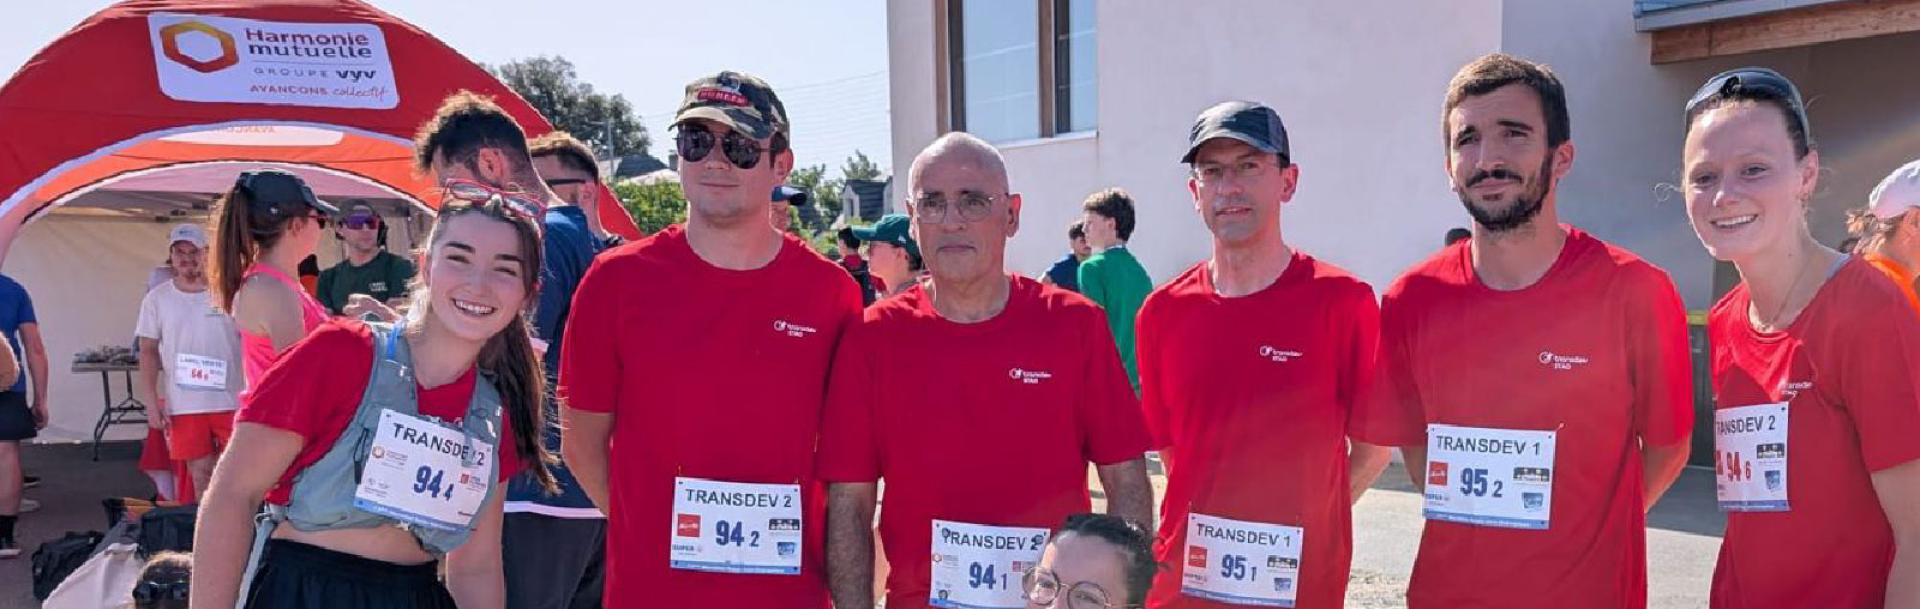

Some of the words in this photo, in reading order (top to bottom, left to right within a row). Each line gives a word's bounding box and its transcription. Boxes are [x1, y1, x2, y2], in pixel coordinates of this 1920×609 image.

[246, 27, 369, 47] Harmonie
[248, 43, 373, 60] mutuelle
[253, 67, 329, 79] GROUPE
[335, 69, 377, 83] vyv
[332, 86, 386, 101] collectif
[1768, 415, 1776, 431] 2
[393, 422, 475, 461] TRANSDE
[476, 451, 485, 467] 2
[1436, 435, 1527, 455] TRANSDEV
[1533, 442, 1541, 456] 1
[1726, 451, 1742, 482] 94
[1745, 461, 1752, 480] 6
[413, 464, 444, 499] 94
[443, 483, 455, 501] 4
[1460, 467, 1489, 498] 95
[1491, 480, 1504, 498] 2
[685, 488, 779, 508] TRANSDEV
[784, 495, 792, 508] 2
[715, 519, 745, 547] 94
[750, 530, 760, 548] 2
[1197, 523, 1280, 546] TRANSDEV
[1284, 536, 1291, 548] 1
[968, 561, 997, 590] 94
[1000, 573, 1008, 591] 1
[1221, 553, 1248, 581] 95
[1250, 566, 1258, 582] 1
